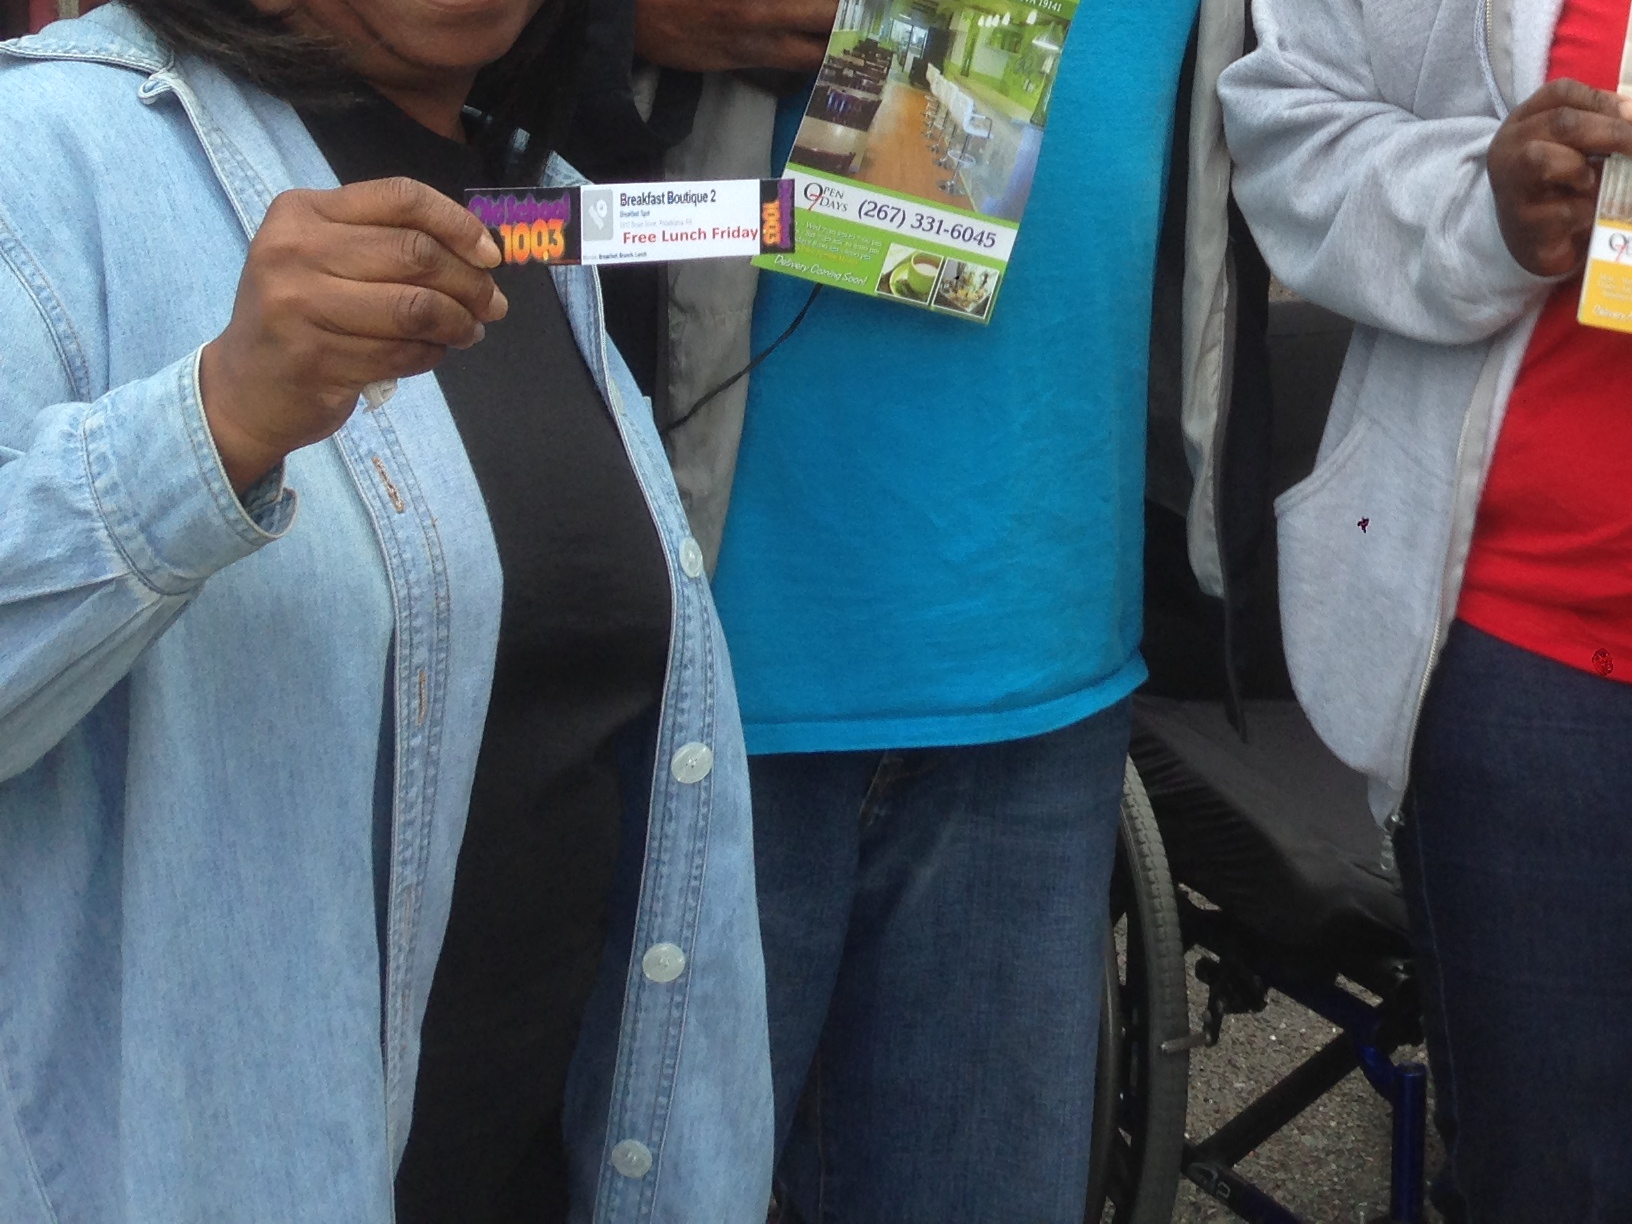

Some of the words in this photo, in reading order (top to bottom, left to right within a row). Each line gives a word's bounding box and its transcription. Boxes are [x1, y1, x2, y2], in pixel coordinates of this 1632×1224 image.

[620, 192, 665, 207] Breakfast
[667, 190, 708, 207] Boutique
[710, 189, 716, 203] 2
[803, 182, 845, 202] OPEN
[819, 197, 849, 213] DAYS
[857, 199, 907, 230] (267)
[910, 212, 997, 249] 331-6045
[623, 232, 657, 245] Free
[661, 228, 707, 243] Lunch
[712, 226, 759, 241] Friday
[774, 254, 810, 273] Delivery
[811, 264, 842, 280] Coming
[844, 272, 868, 286] Soon!
